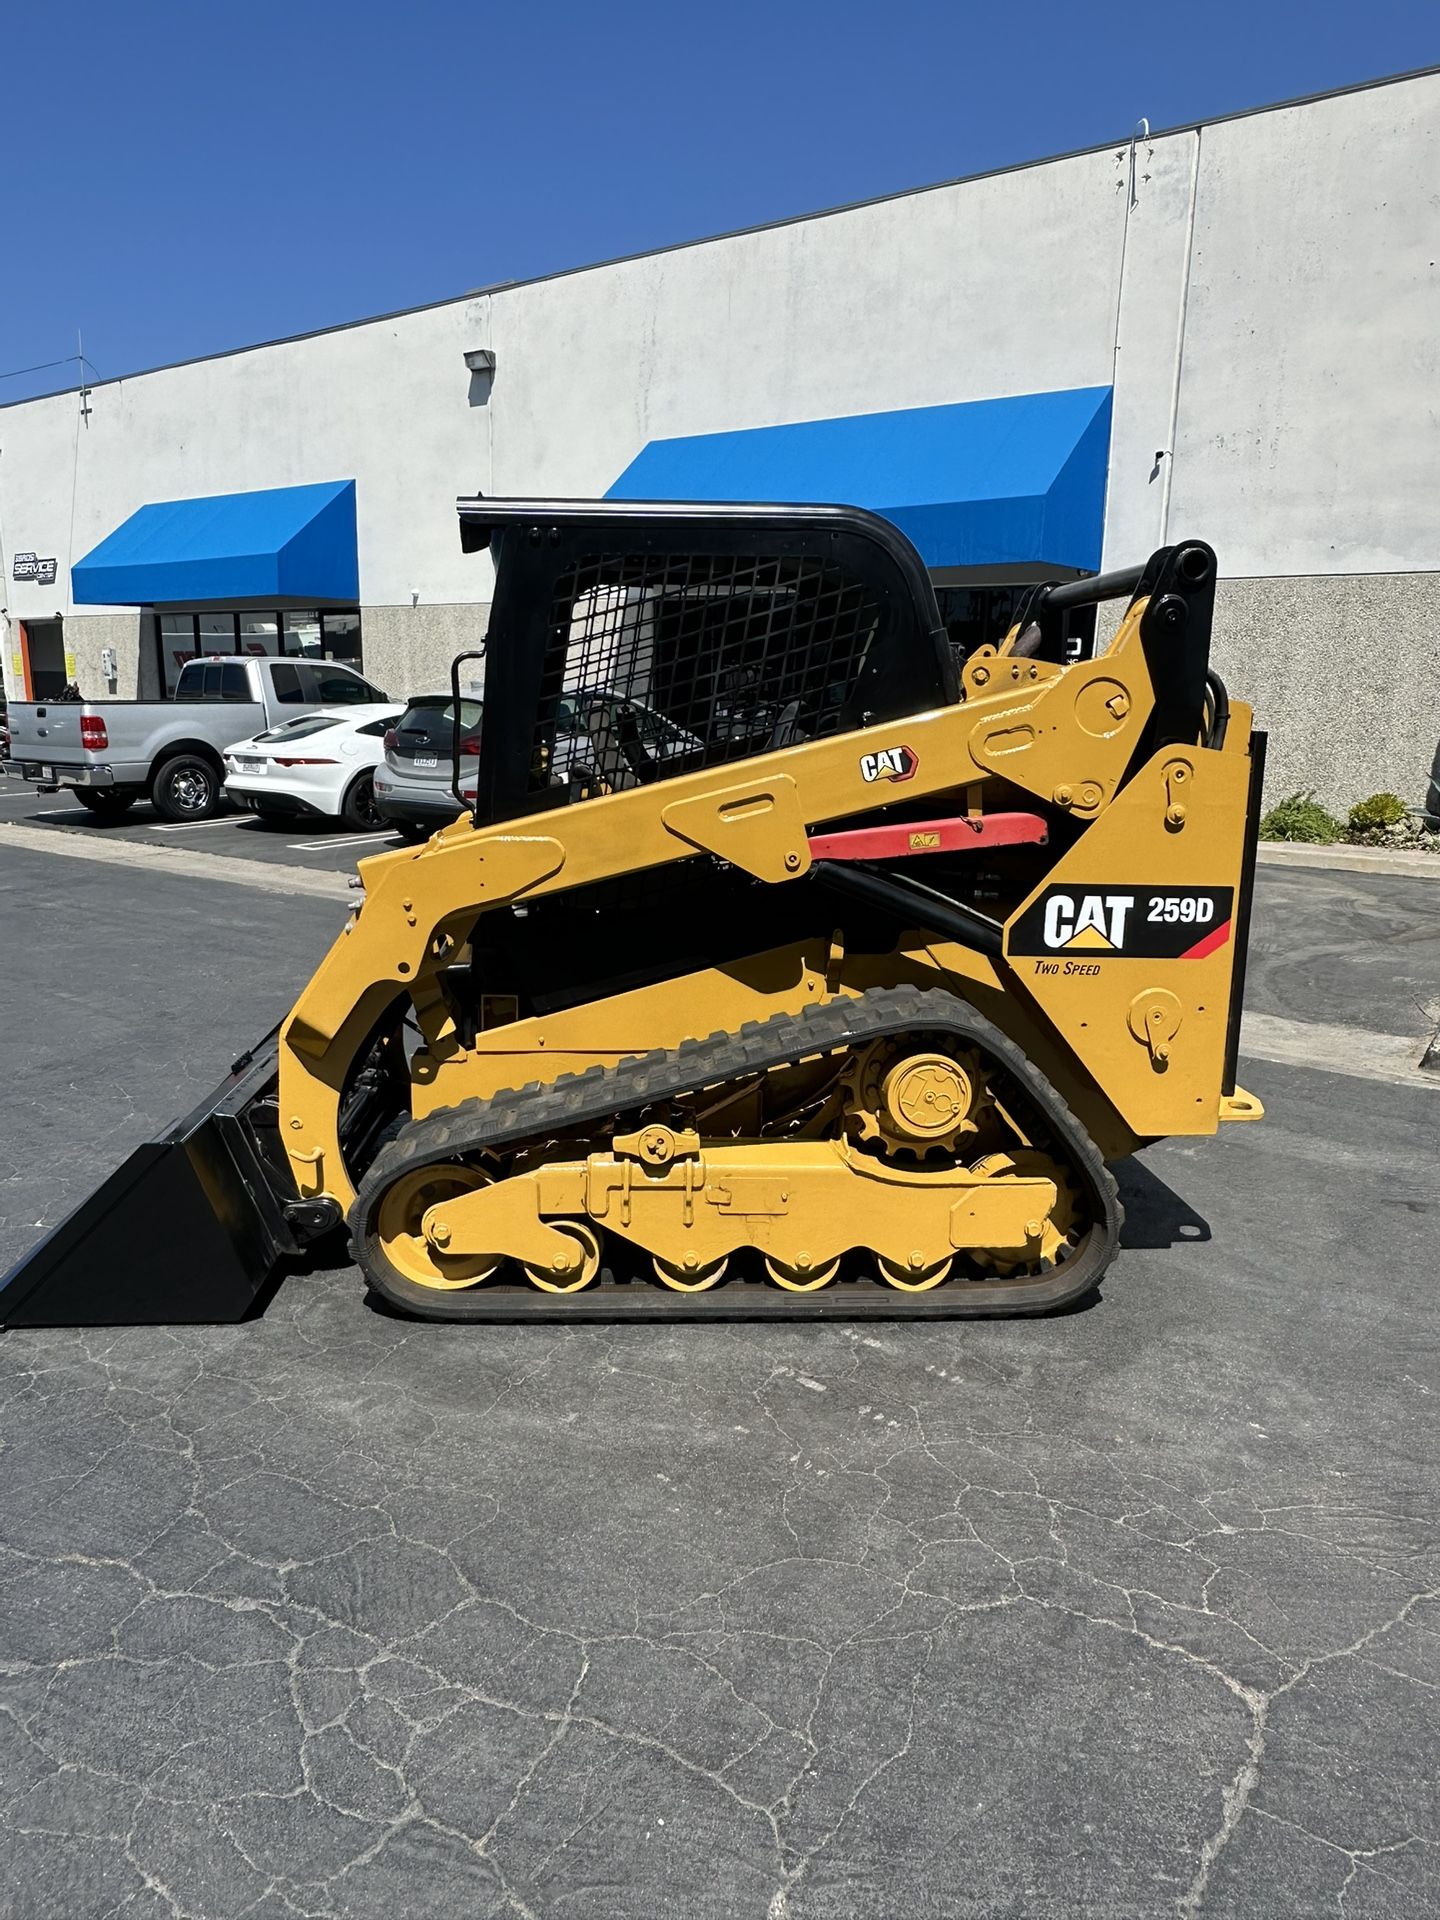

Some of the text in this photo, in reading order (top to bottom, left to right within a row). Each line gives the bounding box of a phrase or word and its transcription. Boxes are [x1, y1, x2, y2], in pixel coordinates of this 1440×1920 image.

[14, 561, 55, 574] SERVICE
[860, 747, 903, 782] CAT
[1043, 895, 1214, 949] CAT 259D
